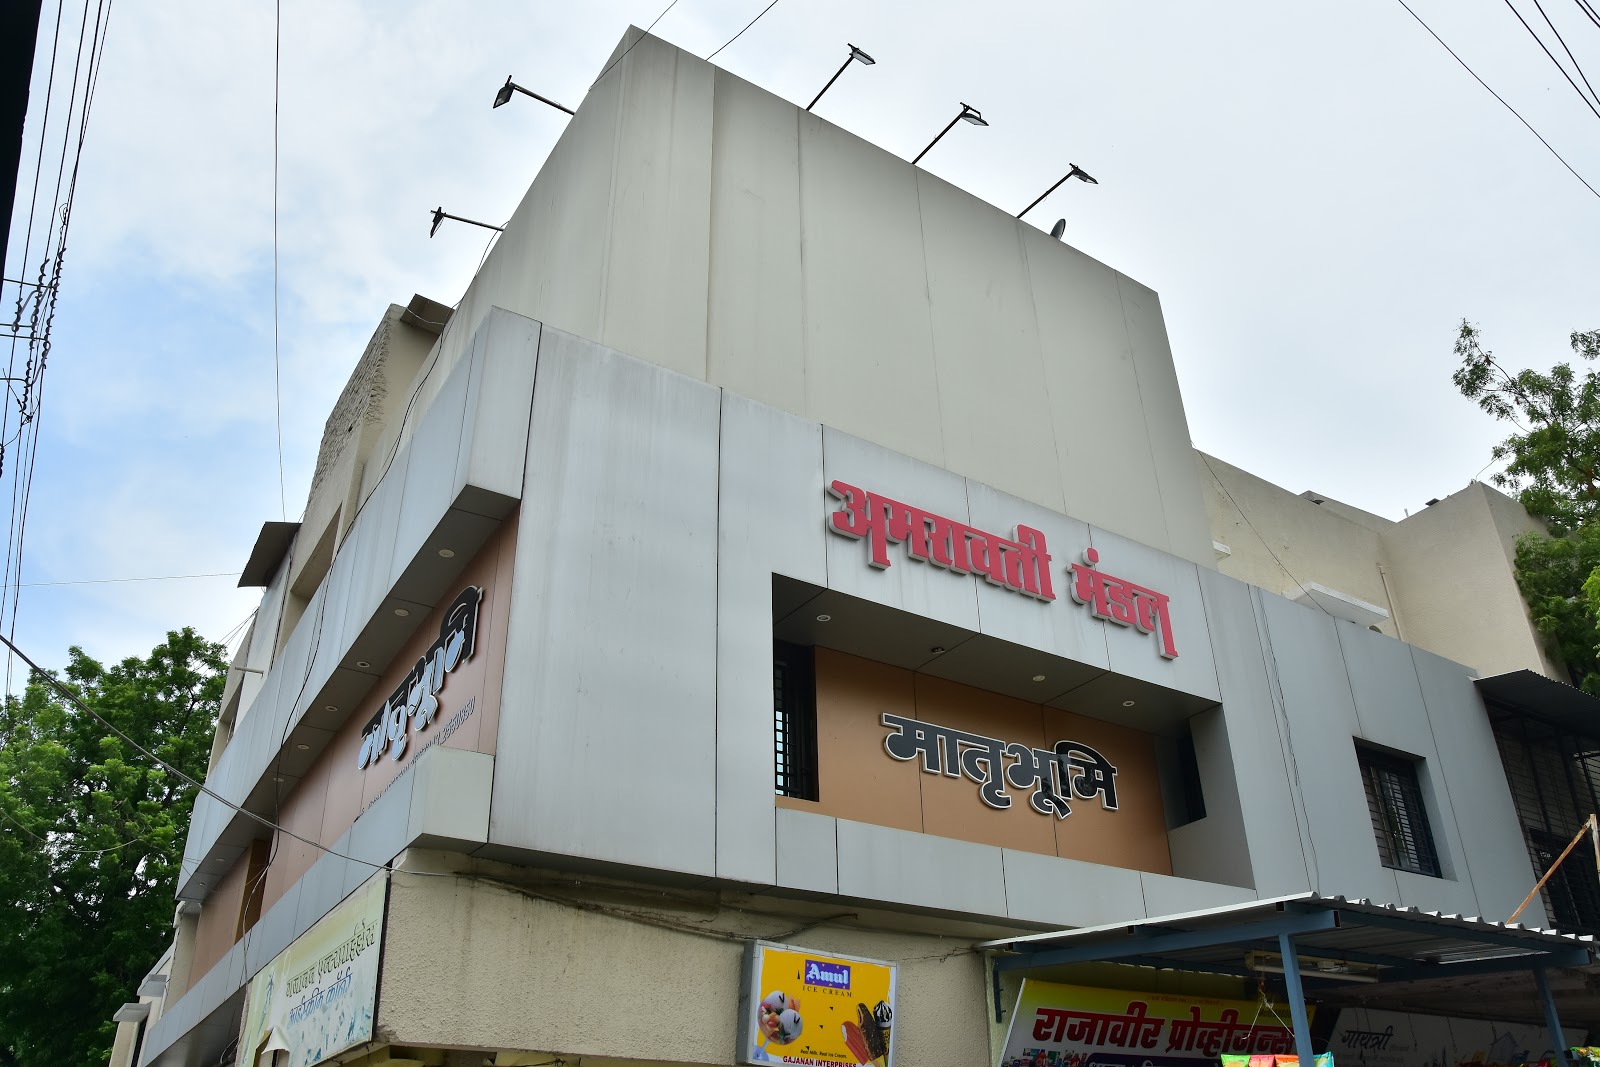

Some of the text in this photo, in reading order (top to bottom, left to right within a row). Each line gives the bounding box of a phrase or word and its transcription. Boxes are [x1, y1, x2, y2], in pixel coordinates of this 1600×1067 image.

[828, 479, 1179, 660] अमरावती मंडल
[358, 585, 483, 770] मातृभूमि
[880, 712, 1119, 820] मातृभूमि
[802, 985, 852, 998] ICE CREAM
[806, 963, 849, 985] Amul
[1032, 1001, 1165, 1050] राजावीर
[1341, 1024, 1395, 1051] गायत्री
[782, 1055, 814, 1067] GAJANAN
